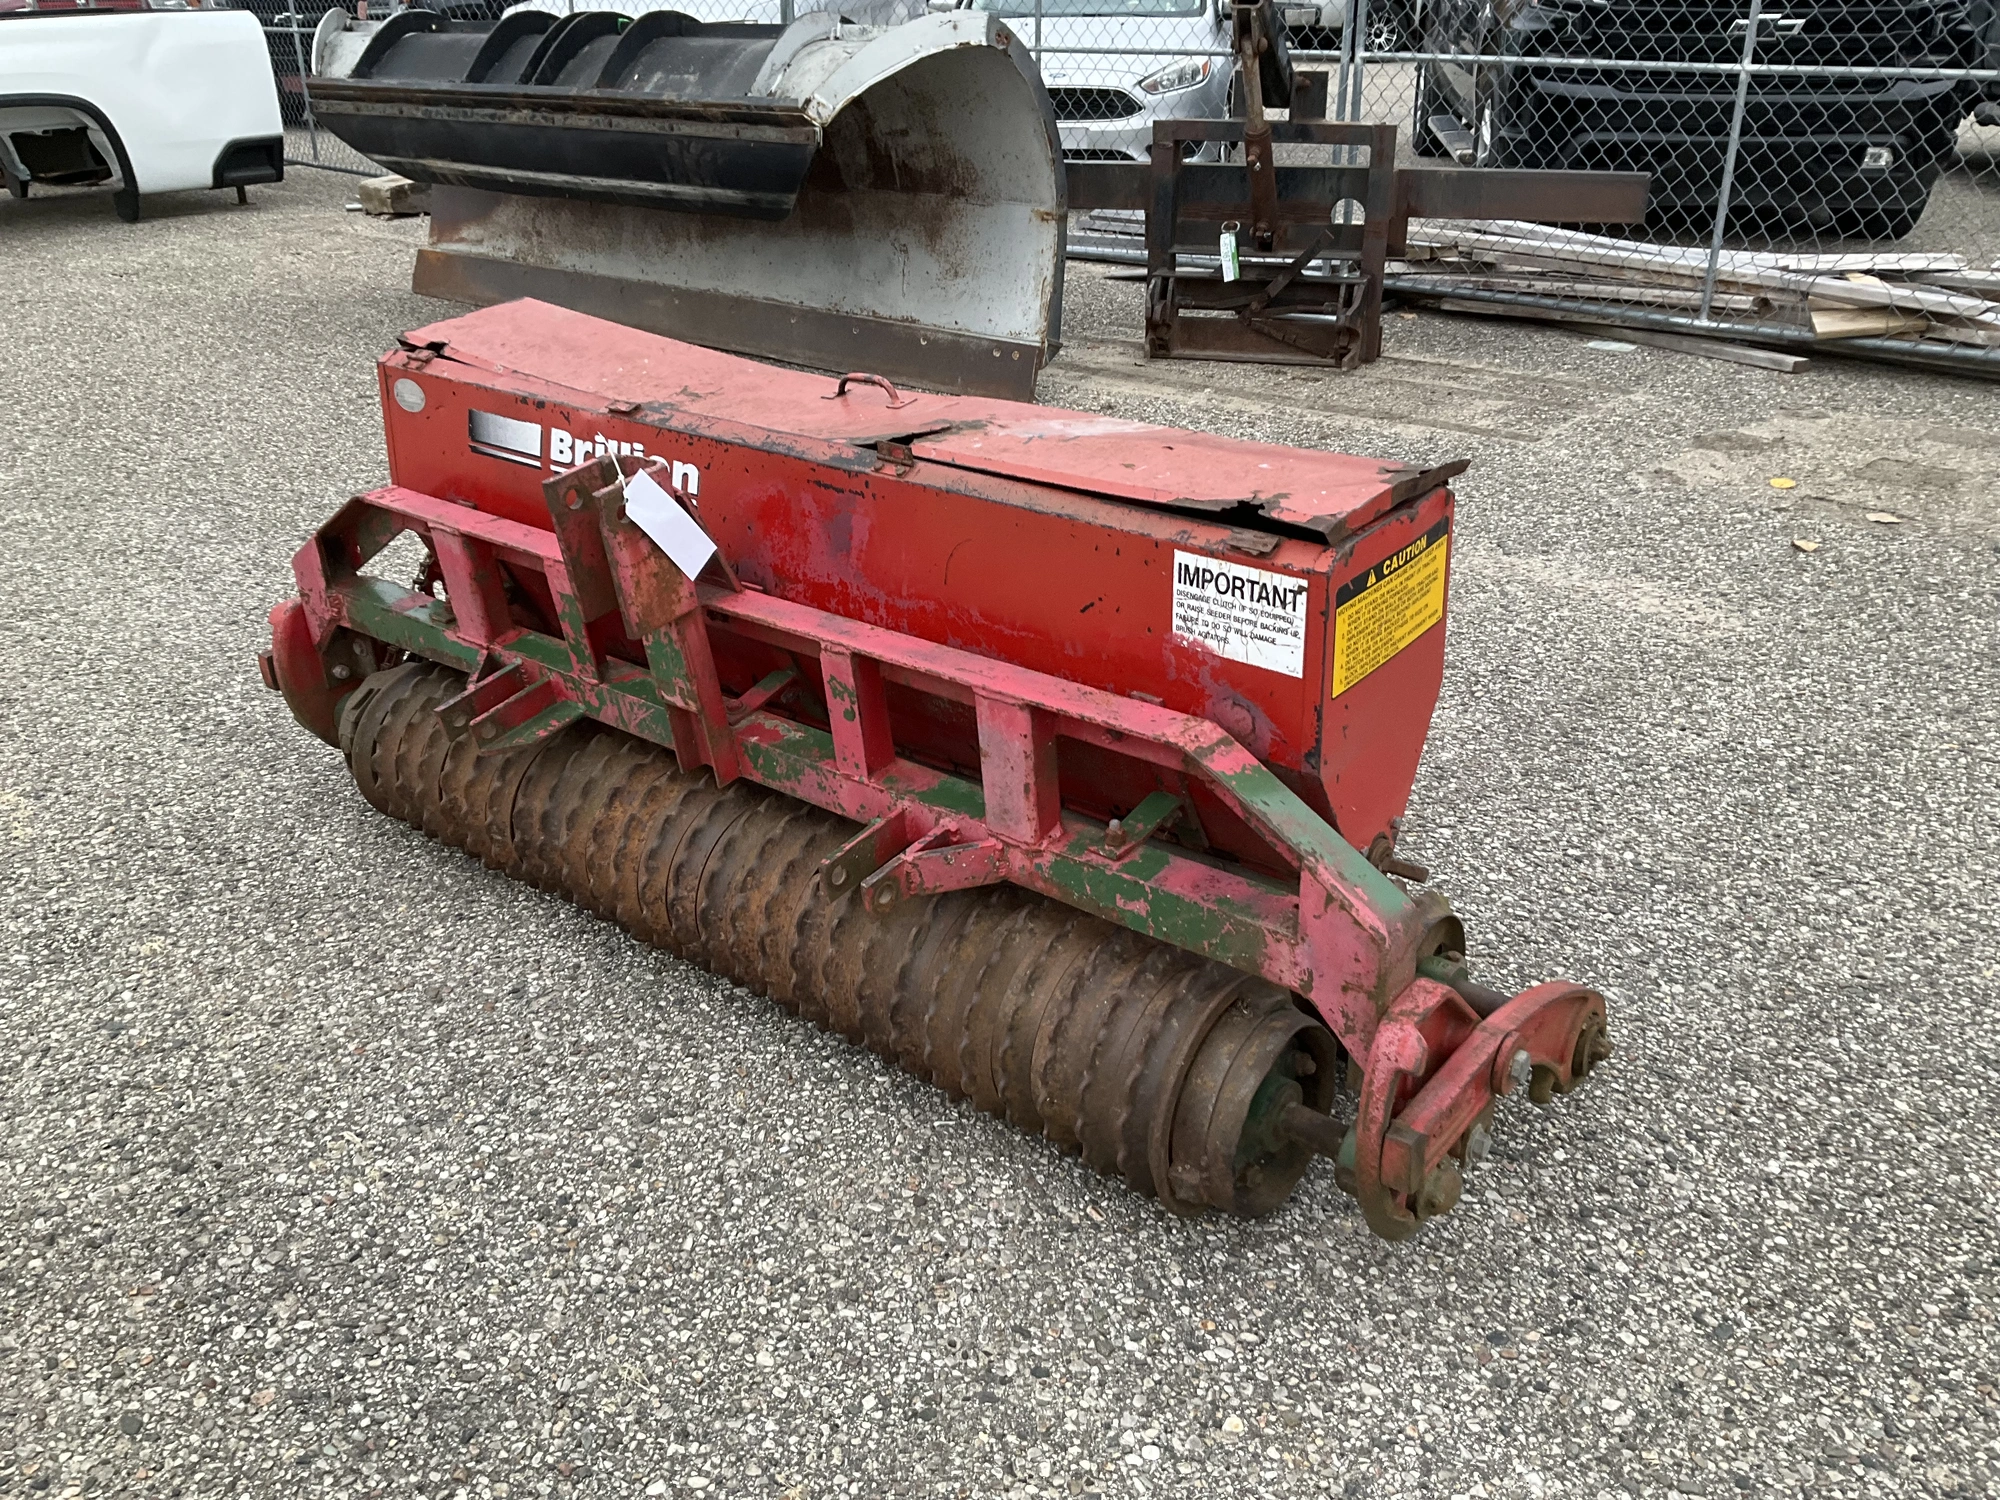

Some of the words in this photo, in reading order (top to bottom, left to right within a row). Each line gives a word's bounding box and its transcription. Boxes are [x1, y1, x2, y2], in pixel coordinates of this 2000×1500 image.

[550, 427, 700, 495] Brin
[1383, 534, 1427, 575] CAUTION
[1176, 589, 1211, 604] DISENGAGE
[1212, 597, 1237, 610] CLUTCH
[1249, 606, 1259, 616] SO
[1177, 562, 1299, 612] IMPORTANT
[1337, 600, 1356, 617] MOVING
[1357, 583, 1381, 605] MACHINES
[1394, 566, 1407, 580] CAUSE
[1364, 596, 1378, 609] STAND
[1386, 583, 1397, 596] WALK
[1175, 624, 1196, 636] BRUSH
[1176, 601, 1185, 609] OR
[1187, 604, 1204, 614] RAISE
[1206, 608, 1232, 620] SEEDER
[1233, 615, 1258, 628] BEFORE
[1260, 621, 1289, 636] BACKING
[1201, 619, 1210, 628] TO
[1211, 621, 1221, 630] DO
[1223, 624, 1232, 633] SO
[1234, 628, 1248, 638] WILL
[1250, 631, 1277, 646] DAMAGE
